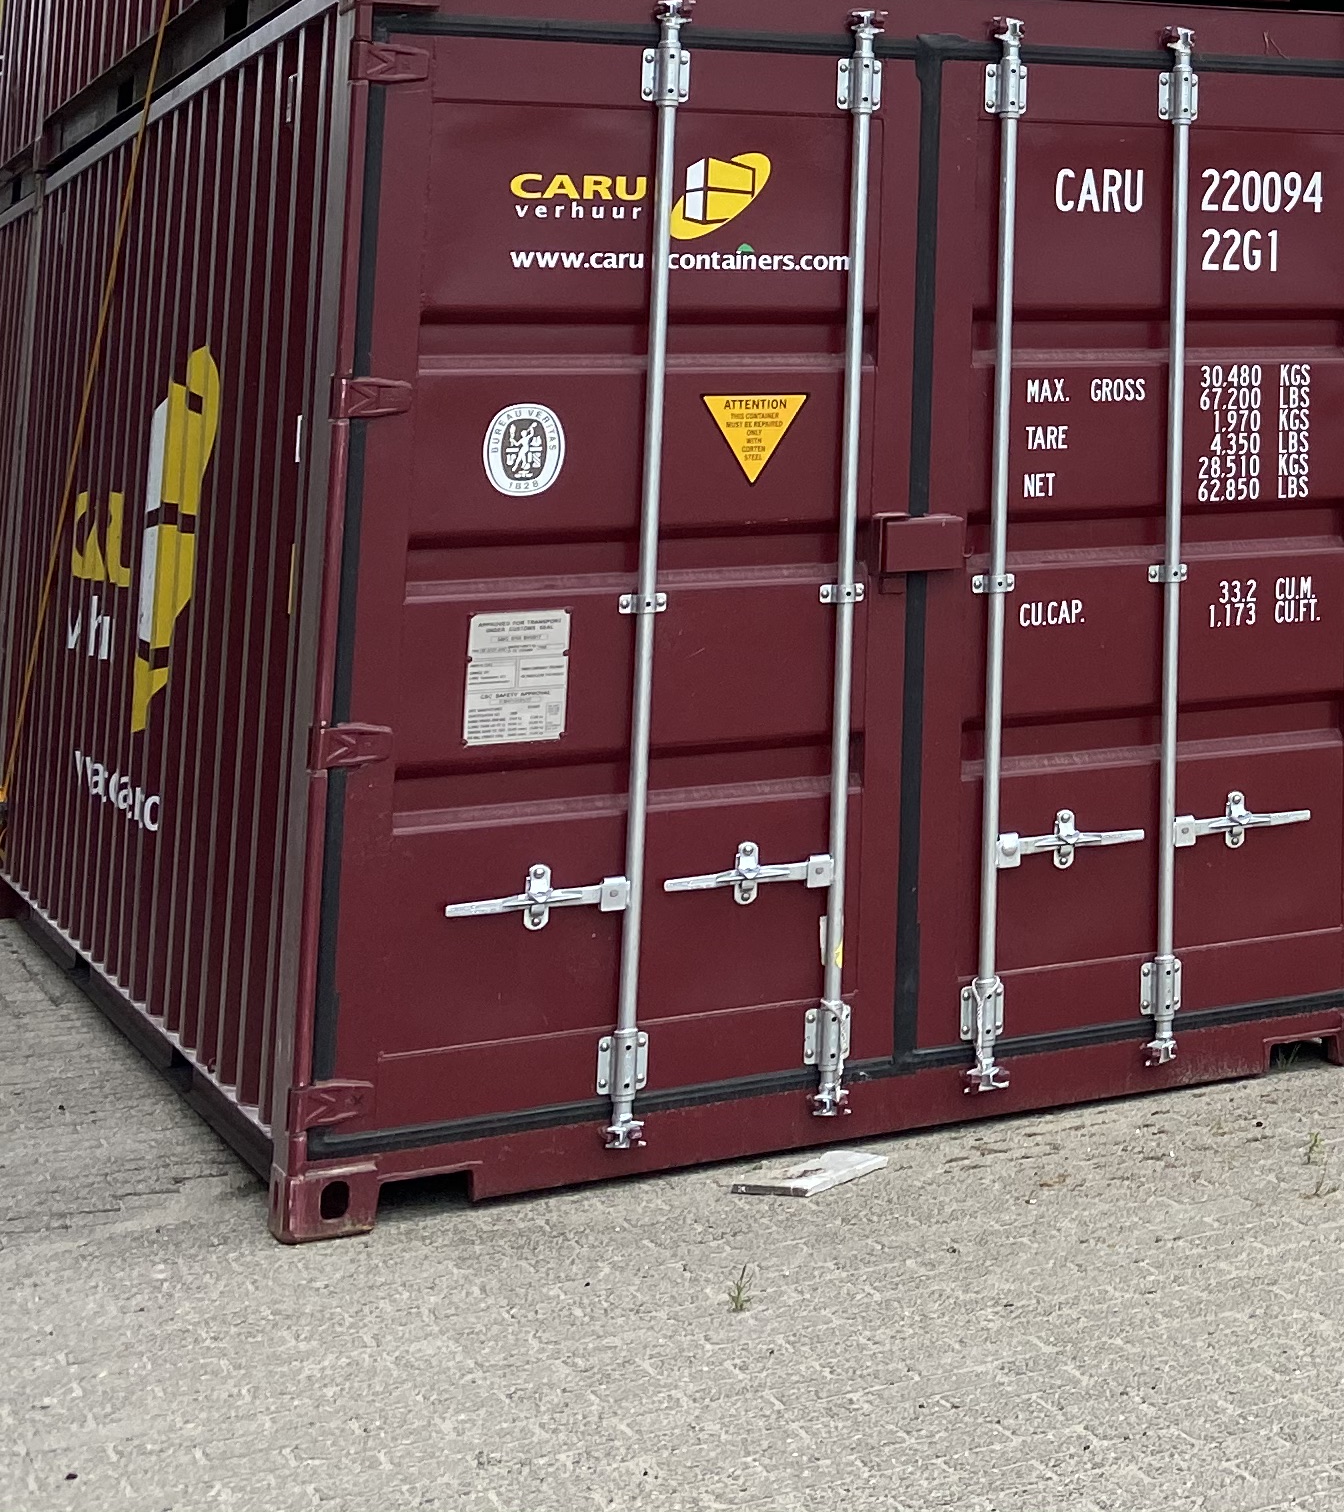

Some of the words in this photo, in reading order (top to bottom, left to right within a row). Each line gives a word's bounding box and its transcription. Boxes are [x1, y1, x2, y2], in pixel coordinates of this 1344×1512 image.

[510, 173, 647, 201] CARU
[1055, 168, 1145, 213] CARU
[1201, 168, 1324, 214] 220094
[515, 201, 643, 220] verhuur
[1201, 228, 1280, 272] 22G1
[1280, 364, 1311, 387] KGS
[1026, 377, 1071, 403] MAX.
[1090, 378, 1147, 402] GROSS
[1279, 386, 1310, 409] LBS
[723, 399, 788, 410] ATTENTION
[745, 412, 780, 420] CONTAINER
[490, 410, 522, 454] BUREAU
[527, 409, 557, 451] VERITAS
[1278, 409, 1310, 431] KGS
[1026, 426, 1069, 451] TARE
[1278, 430, 1309, 454] LBS
[1277, 453, 1309, 476] KGS
[508, 480, 539, 490] 1828
[1023, 473, 1055, 498] NET
[1277, 475, 1309, 499] LBS
[1218, 578, 1257, 604] 33.2
[1275, 575, 1316, 600] CU.M.
[1019, 599, 1085, 627] CU.CAP.
[1274, 598, 1321, 624] CU.FT.
